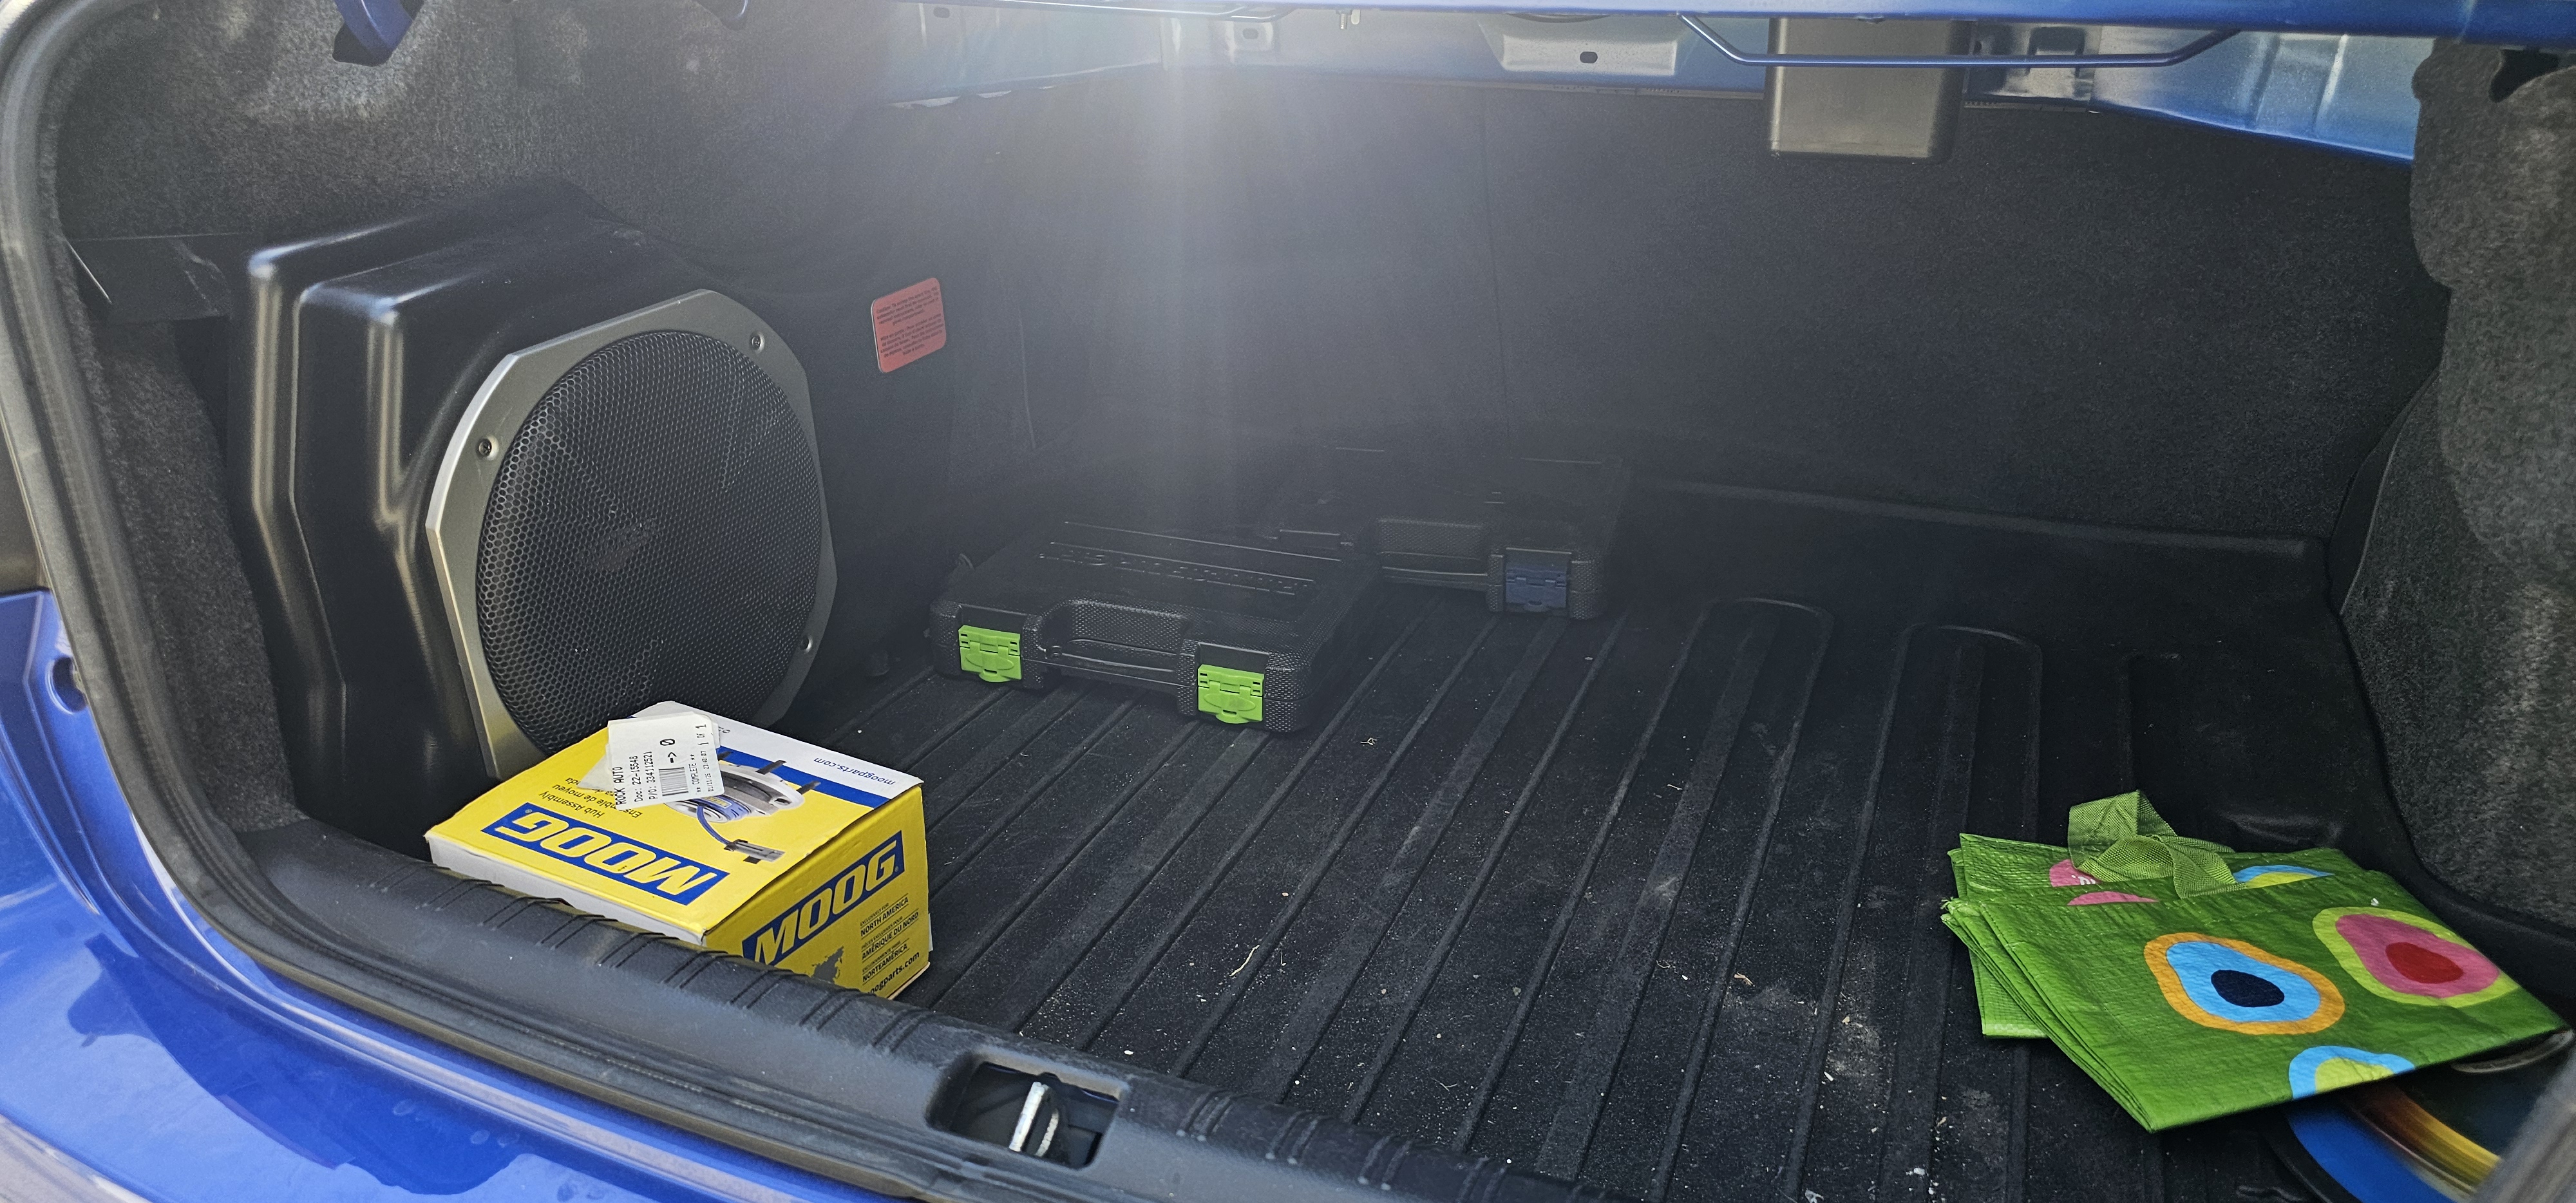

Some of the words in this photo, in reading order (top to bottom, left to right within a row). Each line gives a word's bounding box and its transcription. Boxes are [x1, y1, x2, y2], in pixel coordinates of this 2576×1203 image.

[612, 766, 625, 784] AUTO
[629, 755, 641, 786] 22-15548
[813, 756, 896, 786] moogparts.com
[538, 790, 585, 811] Assembly
[552, 783, 585, 798] moyeu
[614, 788, 627, 806] ROCK
[584, 808, 605, 819] Hub
[495, 811, 718, 896] MOOG
[754, 839, 898, 966] MOOG
[860, 916, 882, 937] NORTH
[882, 896, 909, 921] AMERICA
[862, 931, 893, 960] AMÉRIQUE
[893, 924, 902, 936] DU
[903, 911, 919, 929] NORD
[862, 943, 907, 983] NORTEAMÉRICA
[867, 951, 920, 994] oogparts.com
